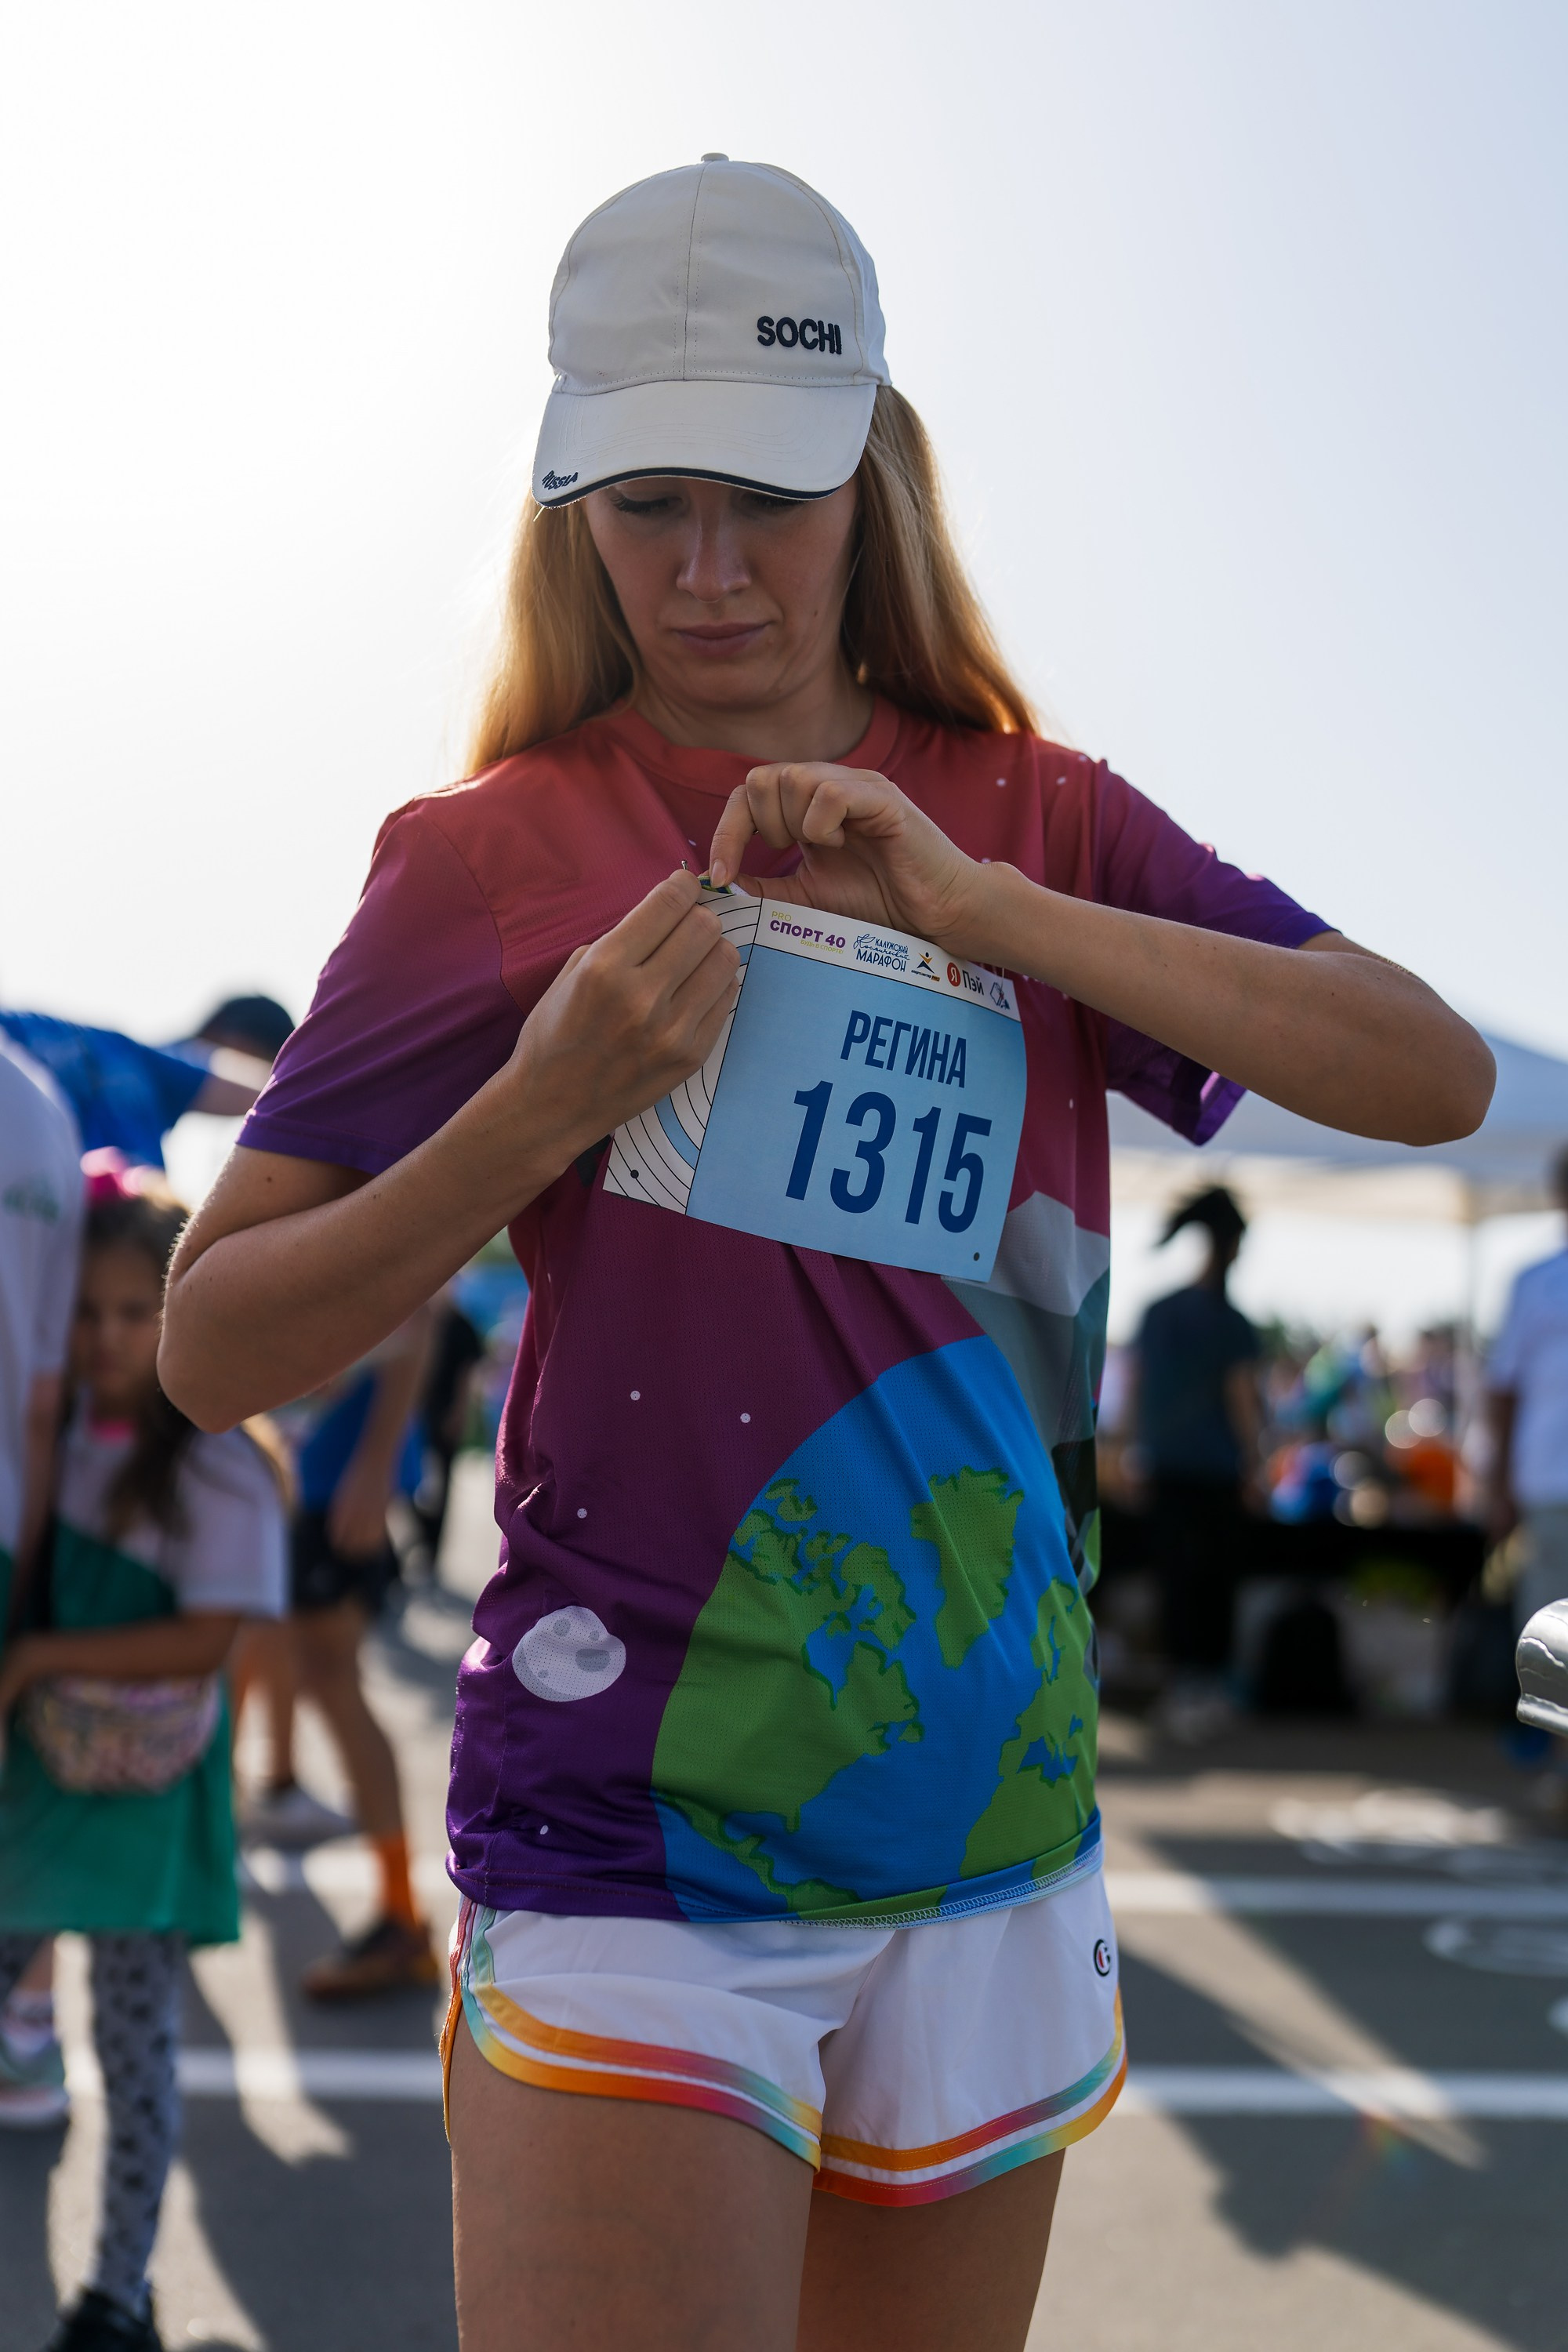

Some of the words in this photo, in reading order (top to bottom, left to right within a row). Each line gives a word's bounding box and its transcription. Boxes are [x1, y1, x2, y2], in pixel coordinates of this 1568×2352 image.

[757, 315, 842, 355] SOCHI
[771, 910, 792, 922] PRO
[770, 920, 823, 942] СПОРТ
[825, 934, 846, 949] 40
[875, 938, 909, 954] КАЛУЖСКИЙ
[856, 948, 906, 972] МАРАФОН
[962, 969, 985, 996] Пэй
[840, 1009, 967, 1089] РЕГИНА
[786, 1080, 993, 1233] 1315
